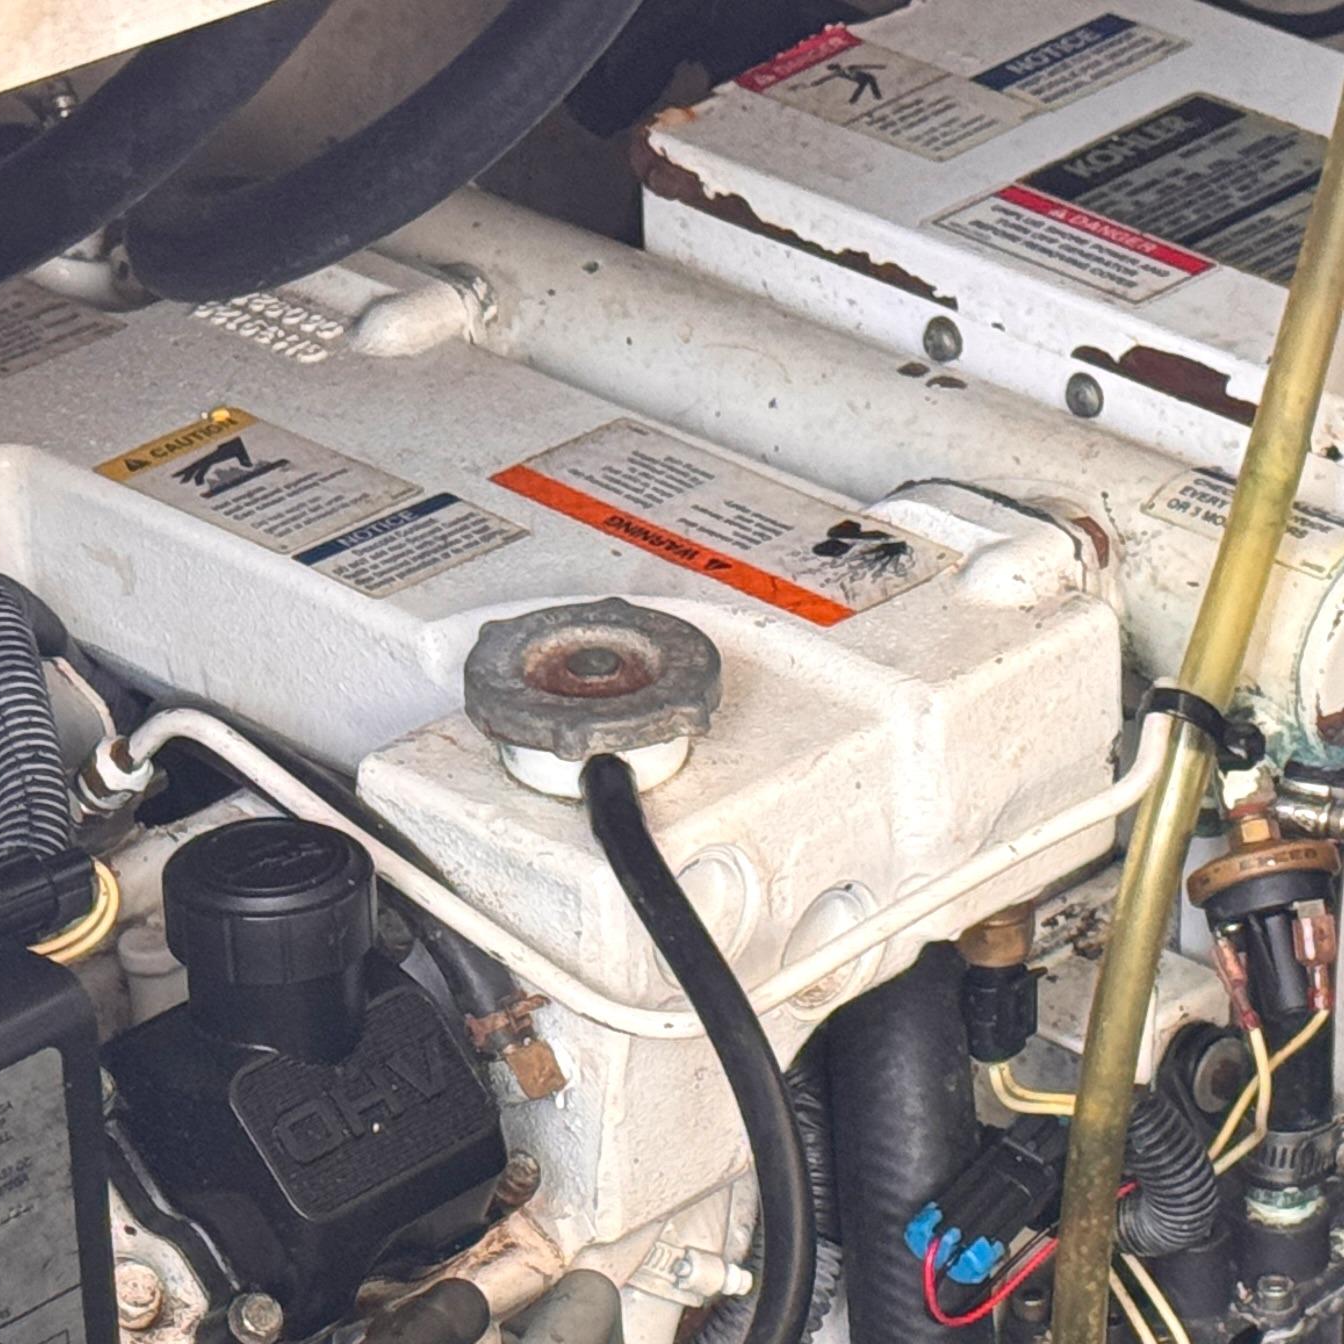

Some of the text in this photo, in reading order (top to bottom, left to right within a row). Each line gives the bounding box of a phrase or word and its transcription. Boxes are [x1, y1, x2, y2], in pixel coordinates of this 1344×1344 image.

[1000, 26, 1106, 76] NOTICE
[150, 415, 239, 460] CAUTION
[337, 509, 416, 549] NOTICE
[604, 514, 700, 562] WARNING
